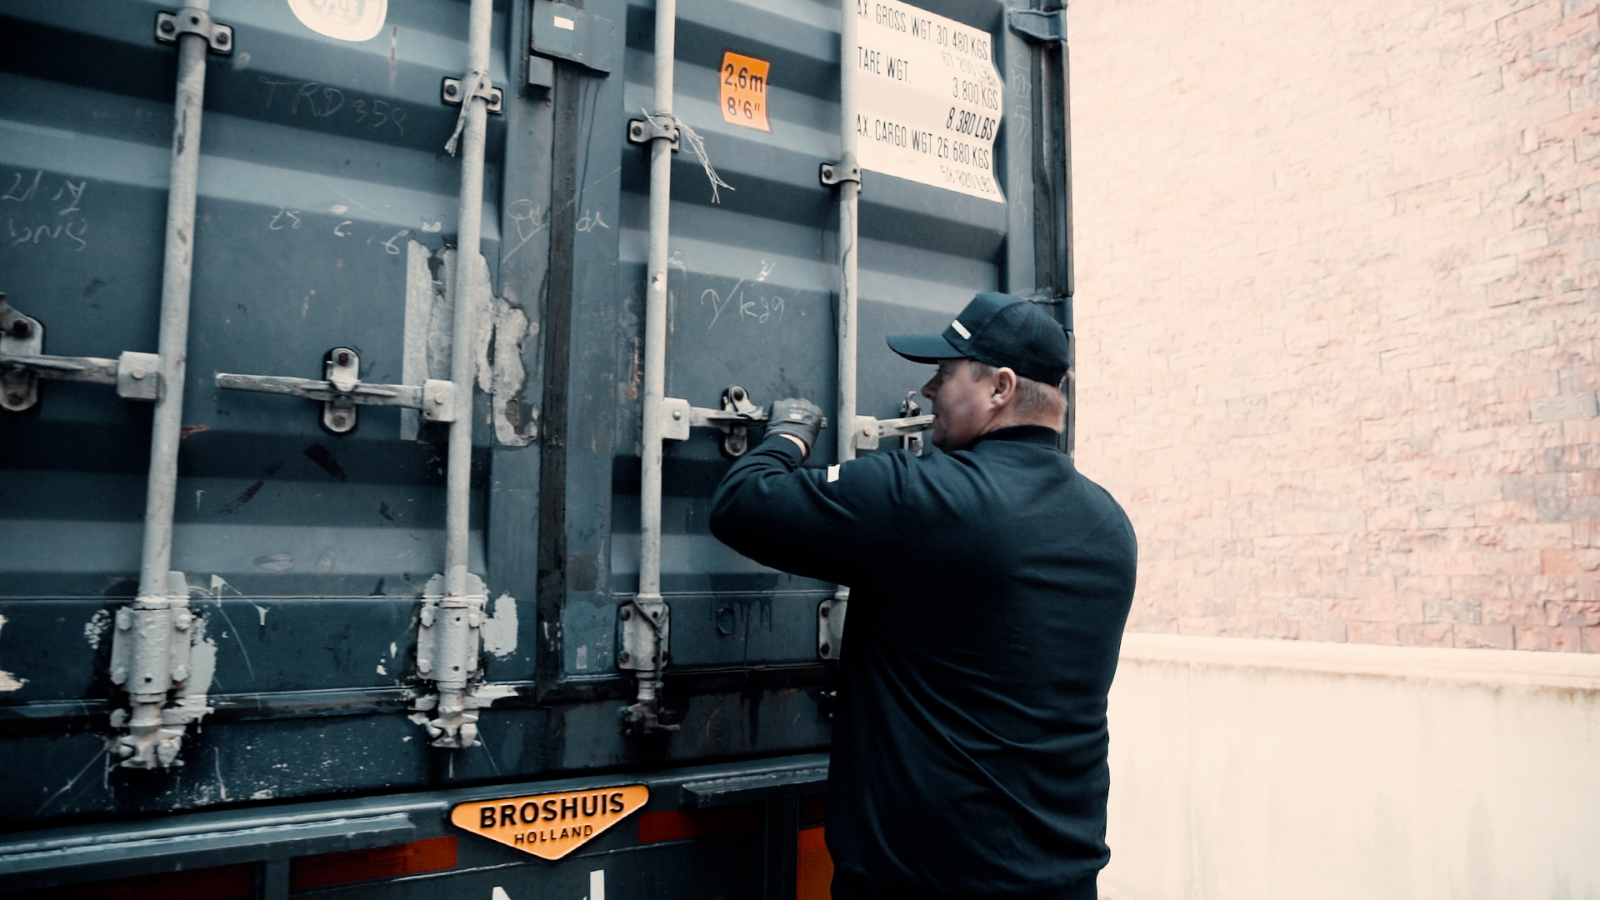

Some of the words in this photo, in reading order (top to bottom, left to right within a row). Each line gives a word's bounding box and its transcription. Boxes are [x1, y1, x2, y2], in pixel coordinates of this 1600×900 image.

[857, 0, 872, 21] AX.
[876, 3, 906, 33] GROSS
[971, 37, 988, 60] KGS
[724, 63, 763, 93] 2,6m
[857, 46, 881, 75] TARE
[886, 55, 911, 84] WGT.
[981, 86, 998, 110] KGS
[857, 113, 872, 139] AX.
[875, 119, 907, 148] CARGO
[972, 146, 989, 170] KGS
[946, 107, 976, 136] 8.380
[975, 115, 996, 141] LBS
[480, 792, 625, 829] BROSHUIS
[514, 824, 593, 845] HOLLAND
